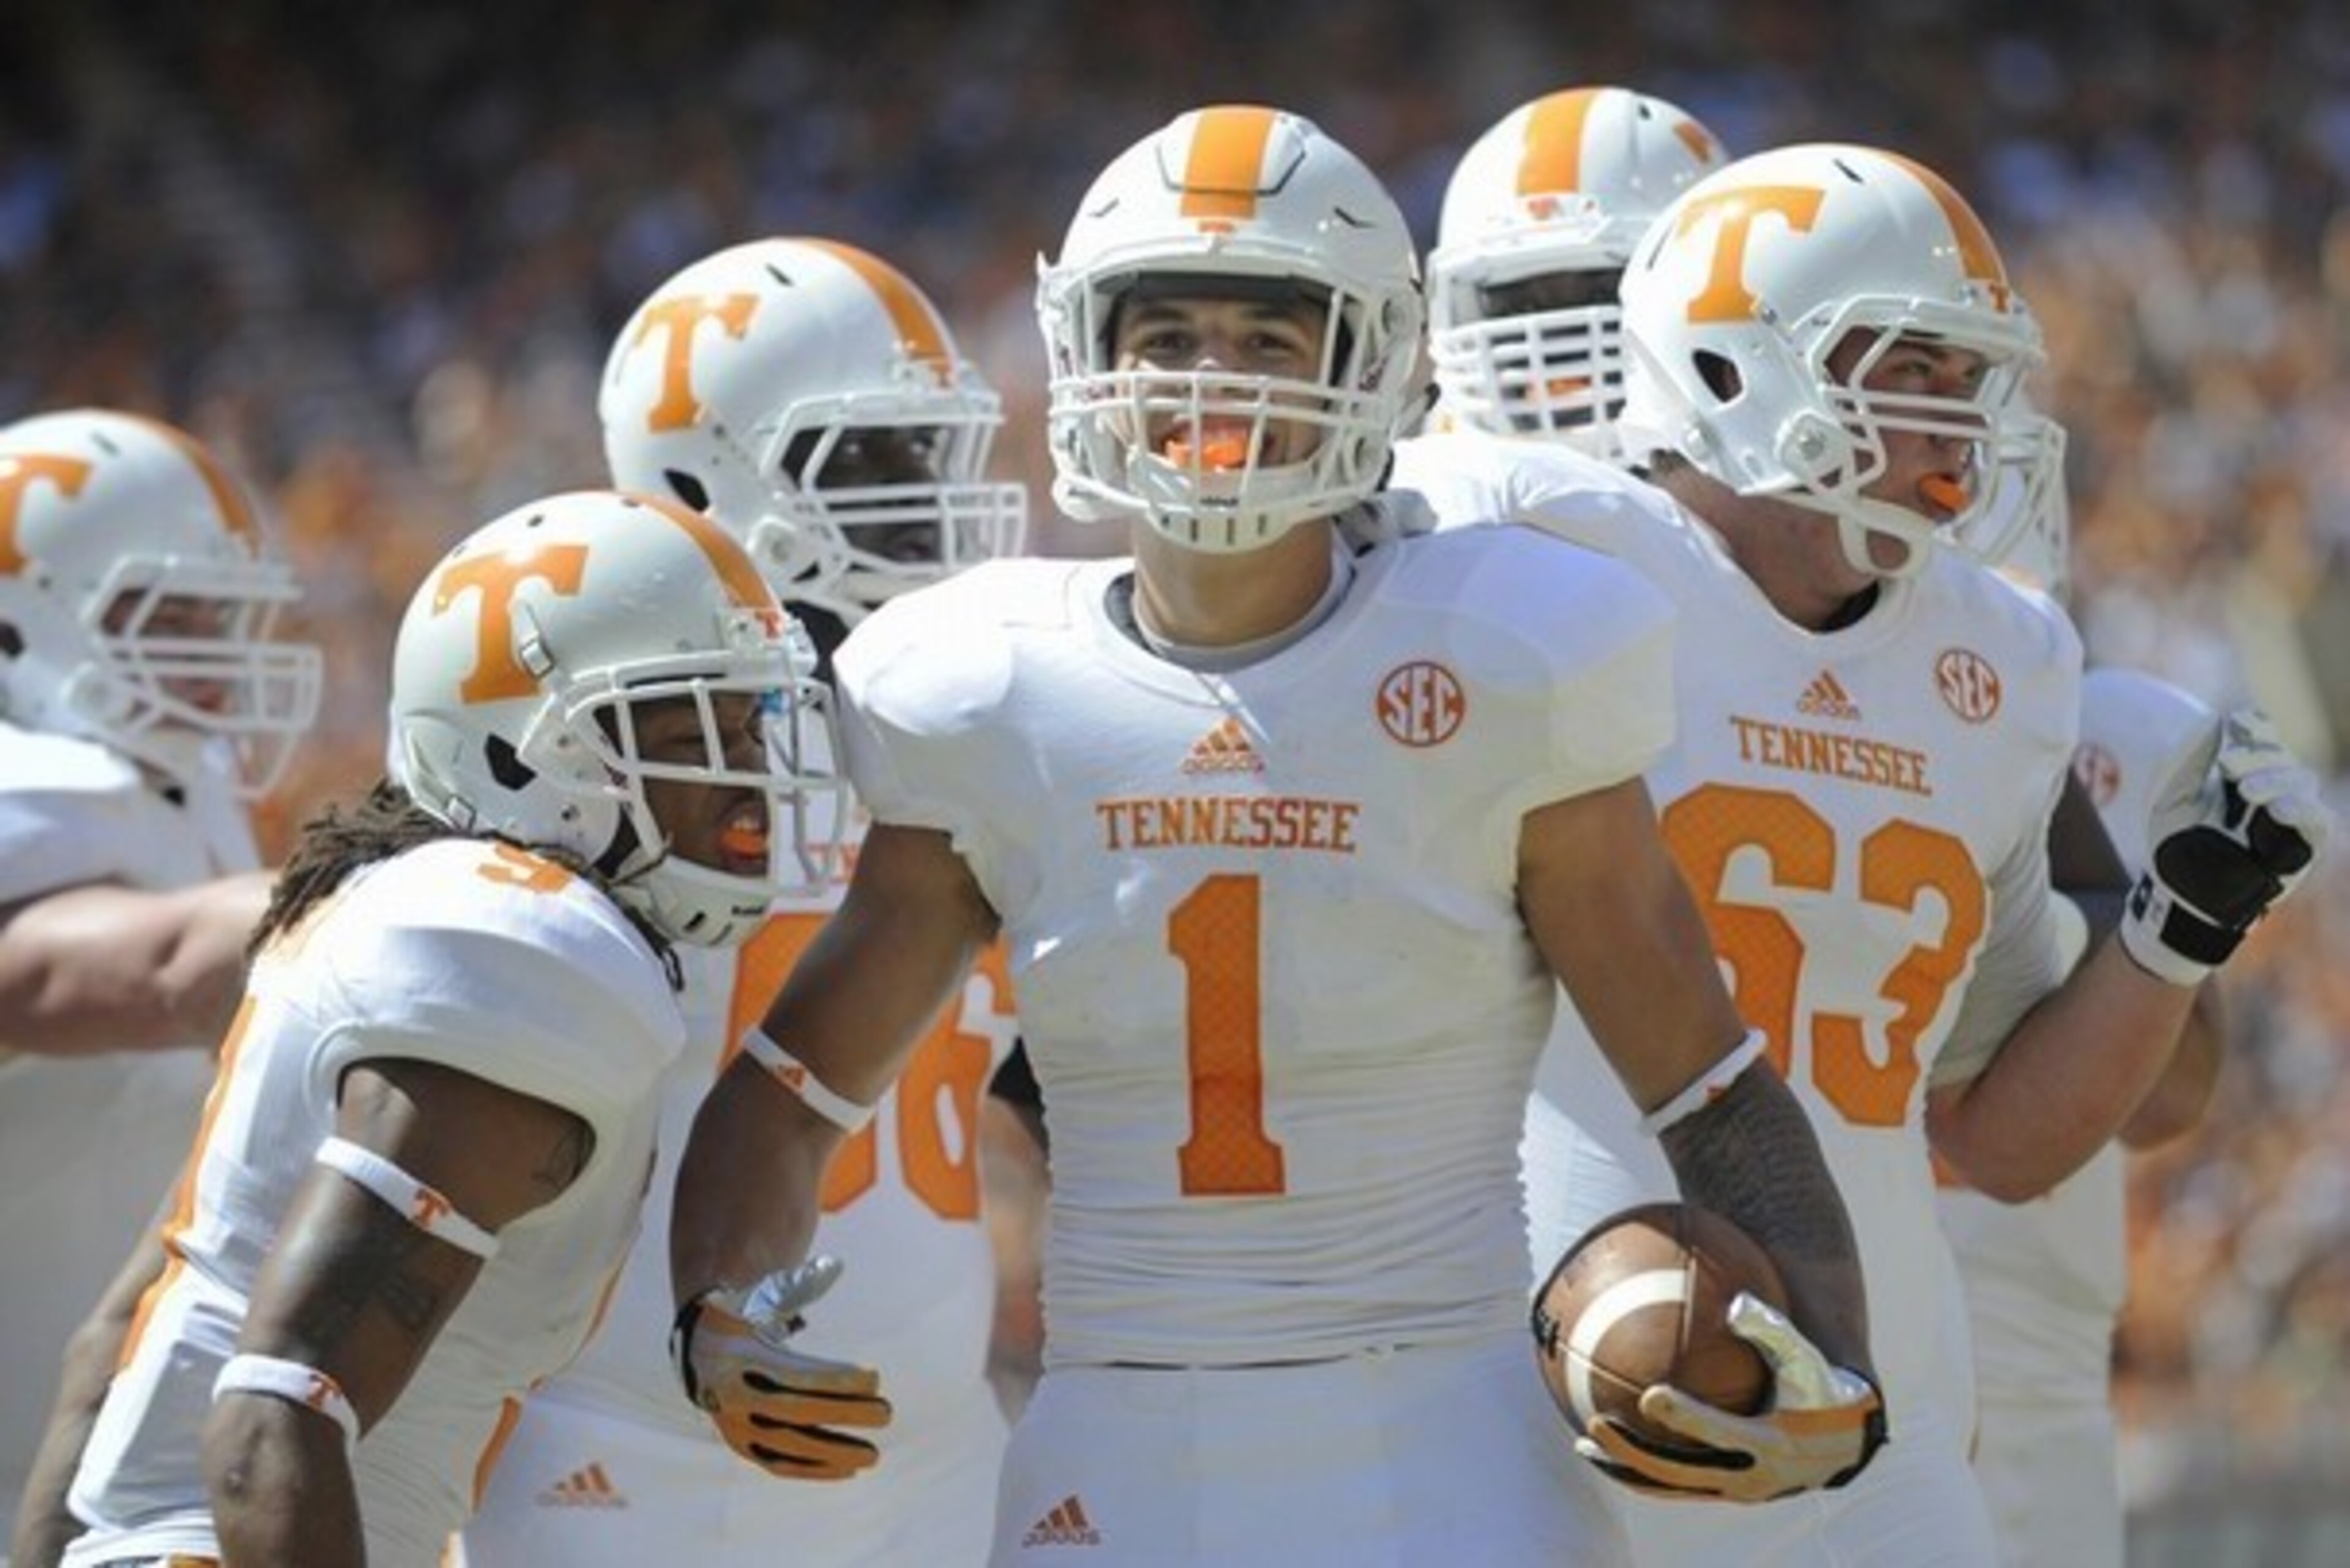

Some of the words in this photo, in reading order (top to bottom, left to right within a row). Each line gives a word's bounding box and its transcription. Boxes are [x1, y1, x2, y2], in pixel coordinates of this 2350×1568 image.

[1676, 186, 1826, 324] T
[633, 294, 761, 434] T
[432, 545, 589, 704] T
[1937, 650, 1999, 723] SEC
[1379, 663, 1463, 745] SEC
[1729, 714, 1933, 797] TENNESSEE
[1096, 798, 1360, 853] TENNESSEE
[1658, 782, 1989, 1127] 63
[1168, 873, 1287, 1197] 1
